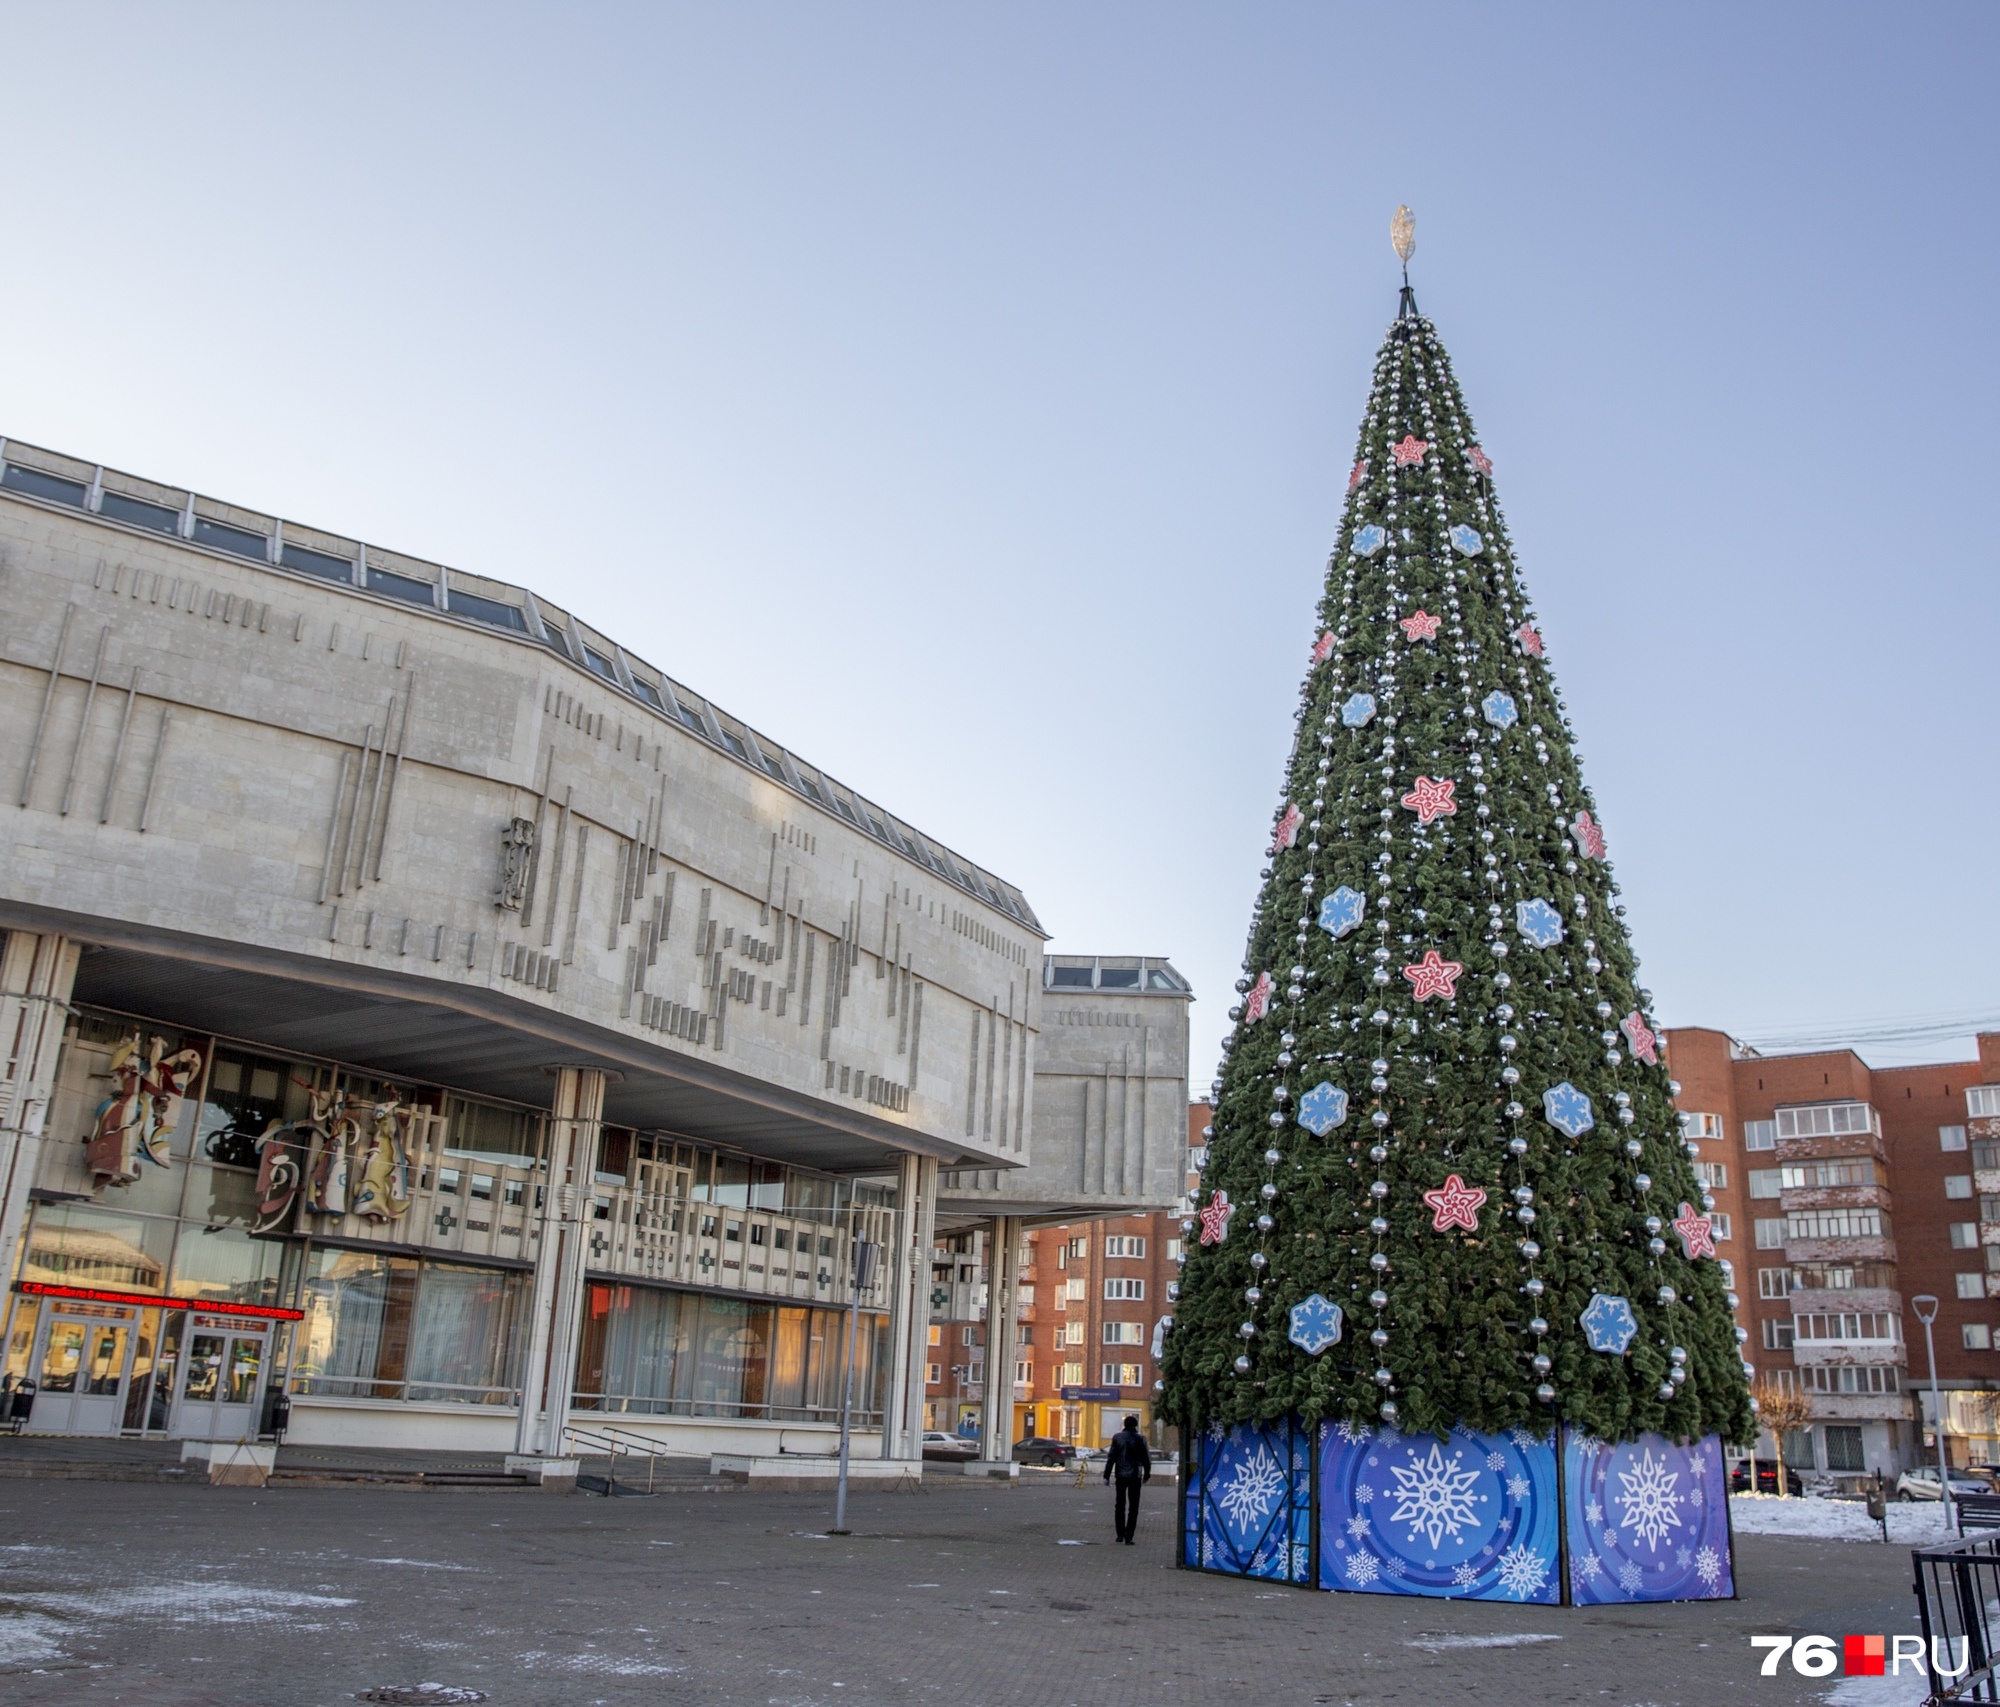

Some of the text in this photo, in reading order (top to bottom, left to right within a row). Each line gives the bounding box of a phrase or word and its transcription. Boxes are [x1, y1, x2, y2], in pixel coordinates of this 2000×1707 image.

[193, 1300, 218, 1311] ТАЙНА
[218, 1302, 255, 1315] СНЕЖНОЙ
[255, 1306, 293, 1318] КОРОЛЕВЫ
